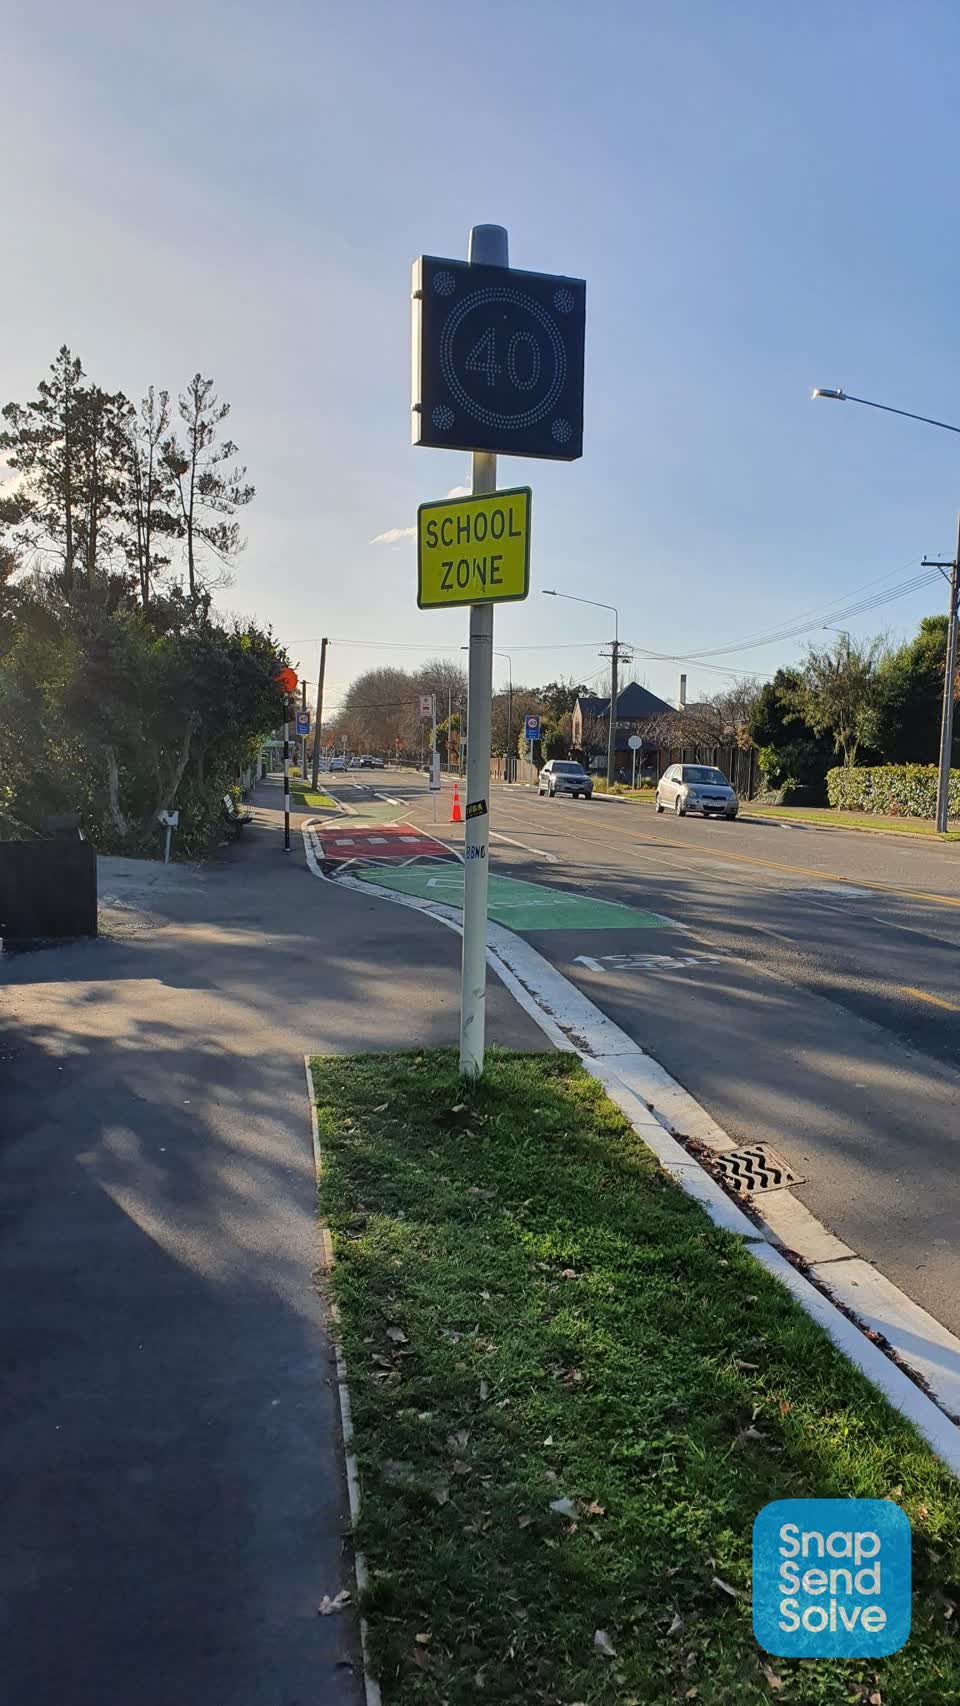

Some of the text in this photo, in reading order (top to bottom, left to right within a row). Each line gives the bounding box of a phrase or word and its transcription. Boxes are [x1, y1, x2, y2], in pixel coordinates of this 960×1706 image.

[465, 327, 541, 391] 40
[426, 507, 522, 549] SCHOOL
[440, 554, 503, 590] ZONE
